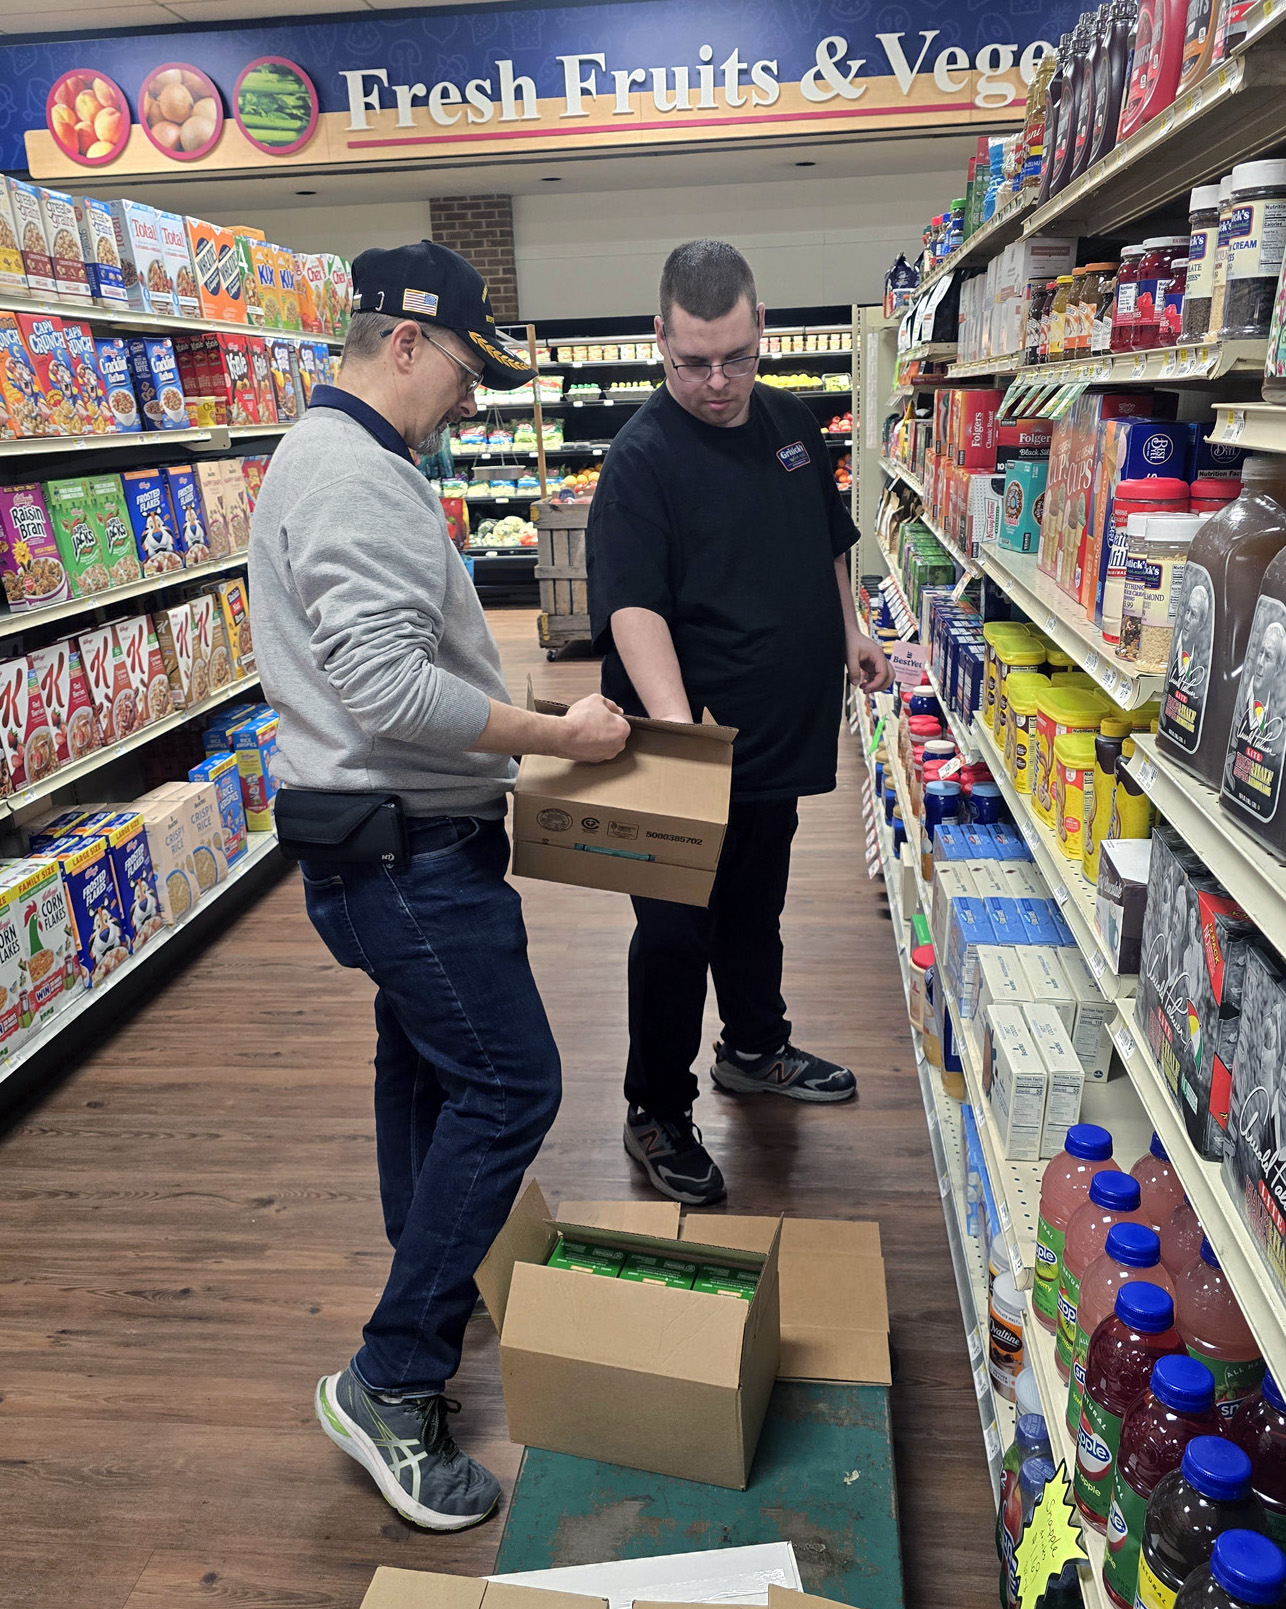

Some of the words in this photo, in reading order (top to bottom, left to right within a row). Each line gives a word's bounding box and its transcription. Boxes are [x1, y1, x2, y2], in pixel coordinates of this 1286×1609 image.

[340, 60, 540, 130] Fresh
[556, 44, 780, 118] Fruits
[801, 35, 867, 101] &
[875, 30, 1055, 108] Vege
[45, 201, 72, 216] great
[132, 219, 157, 241] Total
[161, 228, 185, 248] Total
[1232, 240, 1258, 251] CREAM
[257, 264, 275, 287] KIX
[279, 269, 296, 291] KIX
[29, 331, 67, 356] CRUNCH
[971, 412, 984, 447] Folgers
[1019, 433, 1052, 445] Folger
[1019, 448, 1039, 456] Black
[1067, 458, 1093, 496] CUPS
[136, 488, 160, 505] FROSTED
[139, 498, 160, 513] FLAKES
[11, 506, 45, 526] Raisin
[19, 521, 46, 540] Bran
[105, 524, 127, 553] JACKS
[72, 530, 96, 563] JACKS
[176, 612, 191, 660] K
[126, 624, 146, 675] K
[90, 636, 111, 690] K
[41, 651, 65, 709] K
[1175, 691, 1188, 703] LITE
[1246, 747, 1262, 762] LITE
[191, 803, 213, 824] CRISPY
[197, 817, 212, 832] RICE
[115, 826, 130, 840] LARGE
[130, 818, 140, 831] SIZE
[165, 824, 185, 847] CRISPY
[72, 849, 90, 867] LARGE
[90, 842, 102, 856] SIZE
[125, 843, 145, 872] FROSTED
[171, 838, 184, 855] RICE
[128, 854, 145, 879] FLAKES
[18, 874, 41, 894] FAMILY
[41, 864, 56, 880] SIZE
[83, 869, 107, 900] FROSTED
[41, 892, 64, 918] CORN
[86, 881, 107, 908] FLAKES
[44, 906, 66, 931] FLAKES
[36, 984, 51, 1002] WIN
[1158, 1008, 1172, 1043] LITE
[1261, 1184, 1284, 1233] LITE
[1227, 1367, 1245, 1378] ALL
[1080, 1474, 1101, 1497] apple
[1045, 1498, 1060, 1558] Snapple
